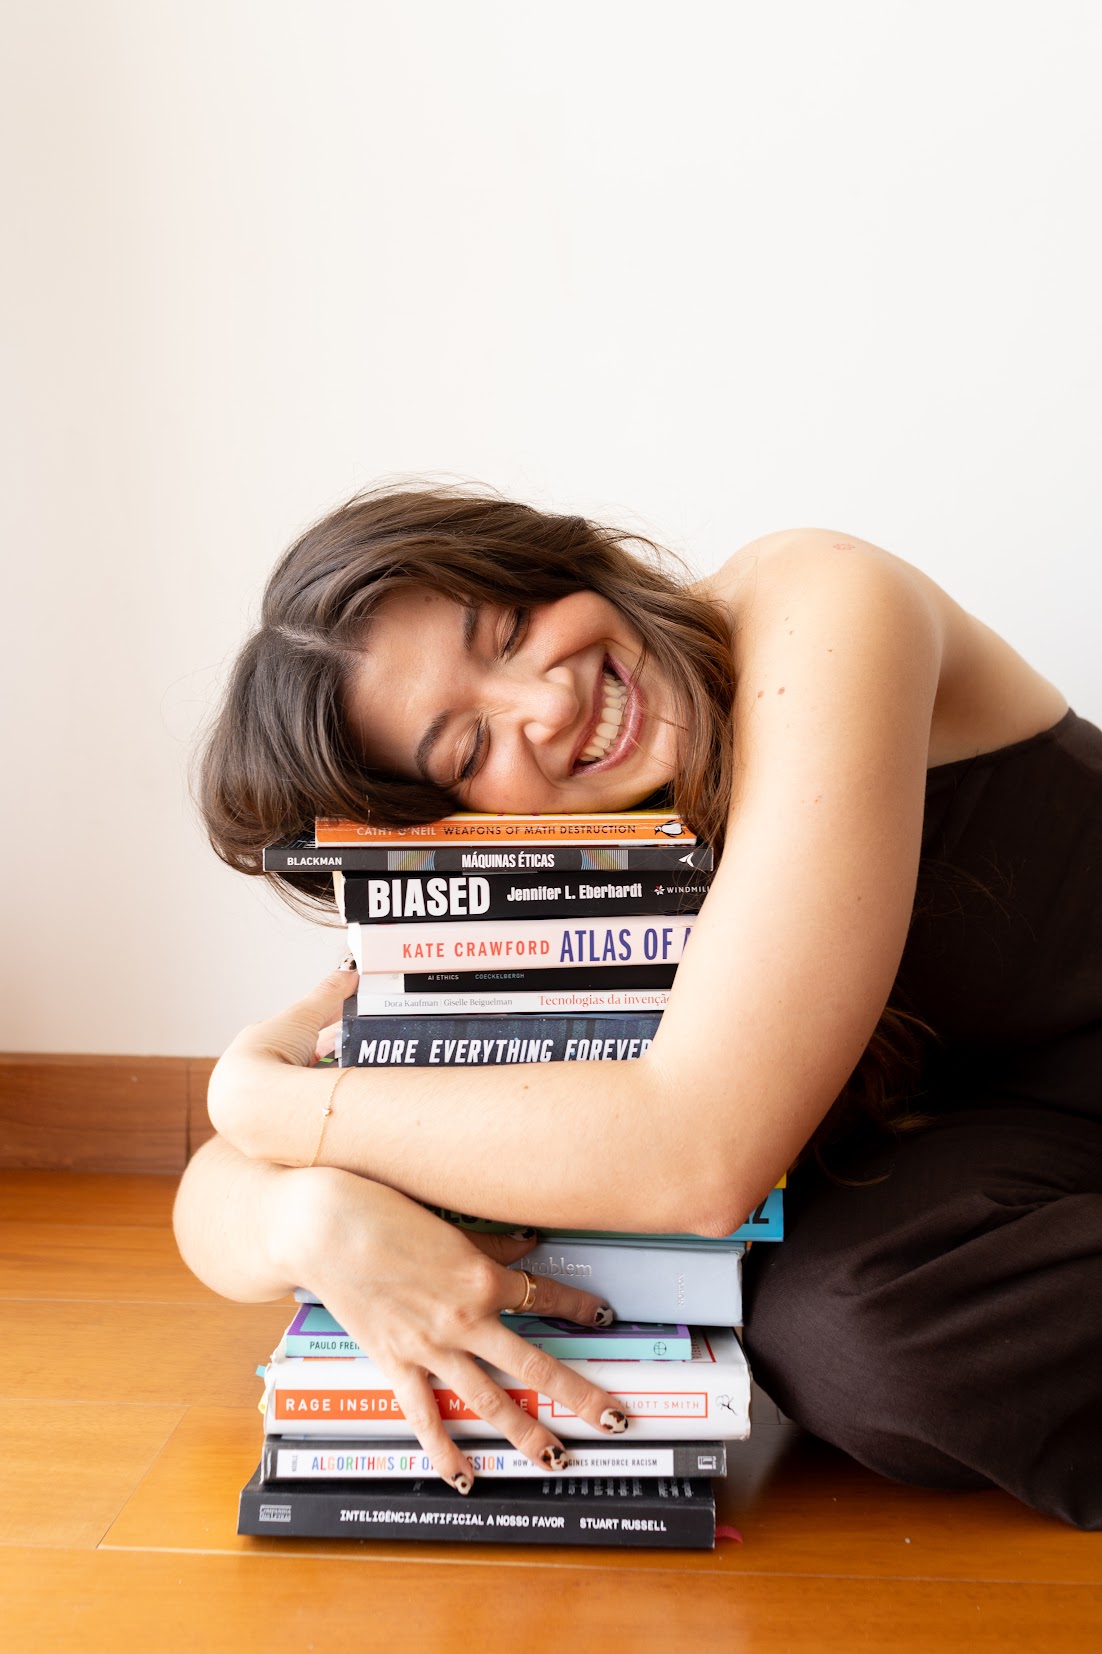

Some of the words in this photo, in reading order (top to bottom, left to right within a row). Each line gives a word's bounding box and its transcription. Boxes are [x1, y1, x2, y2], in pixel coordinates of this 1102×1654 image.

[357, 826, 392, 836] CATHY
[443, 827, 502, 836] WEAPONS
[505, 827, 520, 835] OF
[524, 826, 556, 835] MATH
[560, 825, 636, 834] DESTRUCTION
[287, 857, 342, 866] BLACKMAN
[461, 851, 516, 868] MÁQUINAS
[518, 851, 555, 868] ÉTICAS
[368, 877, 490, 918] BIASED
[507, 886, 562, 901] Jennifer
[565, 886, 576, 900] L.
[579, 883, 643, 899] Eberhardt
[403, 943, 445, 959] KATE
[454, 940, 550, 957] CRAWFORD
[559, 929, 632, 962] ATLAS
[643, 928, 673, 960] OF
[384, 1000, 403, 1008] Dora
[404, 998, 439, 1007] Kaufman
[444, 998, 469, 1007] Giselle
[469, 997, 513, 1008] Beiguelman
[538, 994, 605, 1007] Tecnologias
[607, 994, 621, 1004] da
[357, 1040, 419, 1063] MORE
[428, 1040, 554, 1063] EVERYTHING
[564, 1039, 653, 1061] FOREVER
[520, 1256, 593, 1277] Problem
[310, 1341, 336, 1350] PAULO
[340, 1341, 359, 1350] FREI
[286, 1398, 332, 1411] RAGE
[340, 1398, 400, 1411] INSIDE
[621, 1401, 658, 1409] LIOTT
[664, 1400, 699, 1409] SMITH
[312, 1456, 394, 1471] ALGORITHMS
[400, 1456, 416, 1471] OF
[340, 1509, 418, 1523] INTELIGÊNCIA
[419, 1512, 484, 1526] ARTIFICIAL
[486, 1514, 495, 1526] A
[496, 1514, 529, 1527] NOSSO
[532, 1516, 565, 1528] FAVOR
[580, 1517, 619, 1530] STUART
[621, 1519, 667, 1531] RUSSELL
